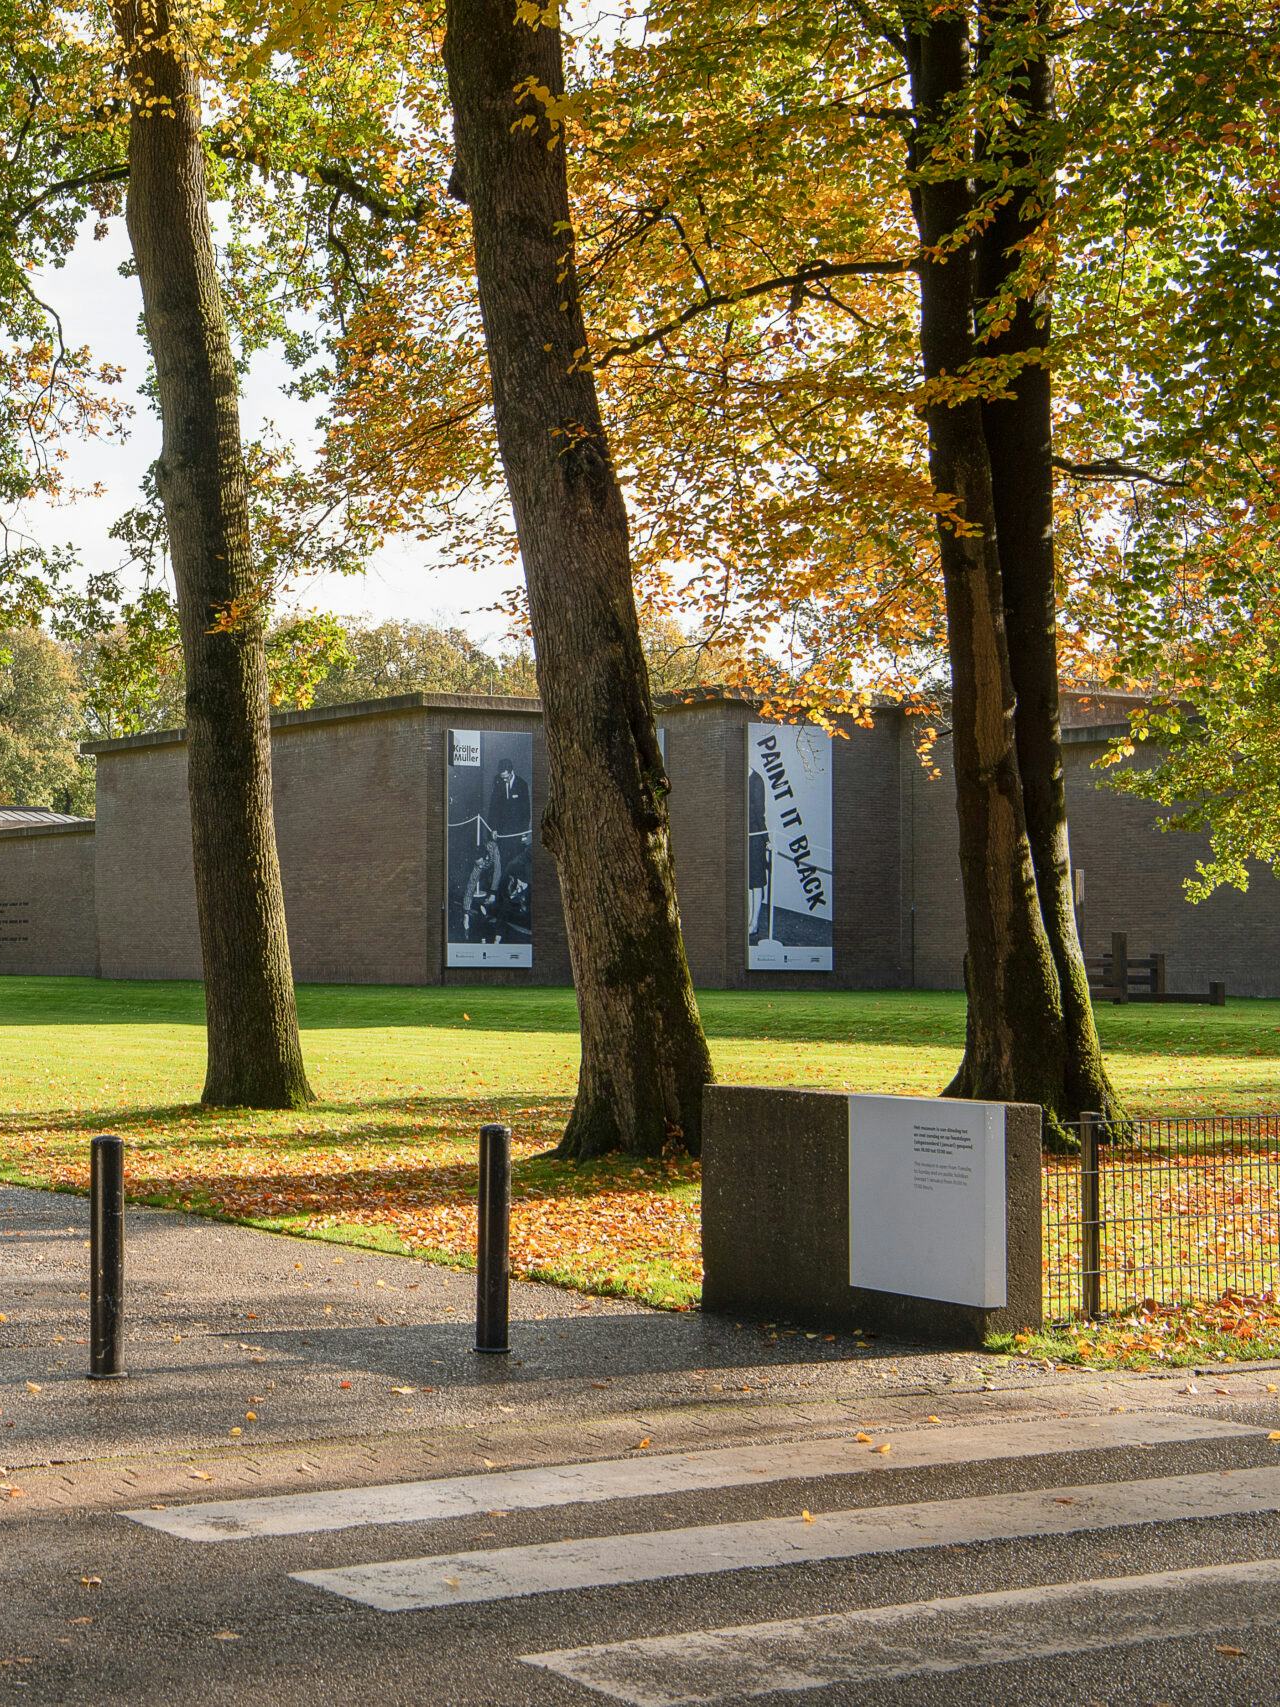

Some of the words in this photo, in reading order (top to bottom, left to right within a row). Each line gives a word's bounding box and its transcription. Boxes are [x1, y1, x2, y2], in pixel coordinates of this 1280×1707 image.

[452, 744, 479, 754] Kröller
[453, 753, 479, 763] Müller
[756, 735, 794, 801] PAINT
[780, 807, 802, 829] IT
[788, 834, 827, 912] BLACK
